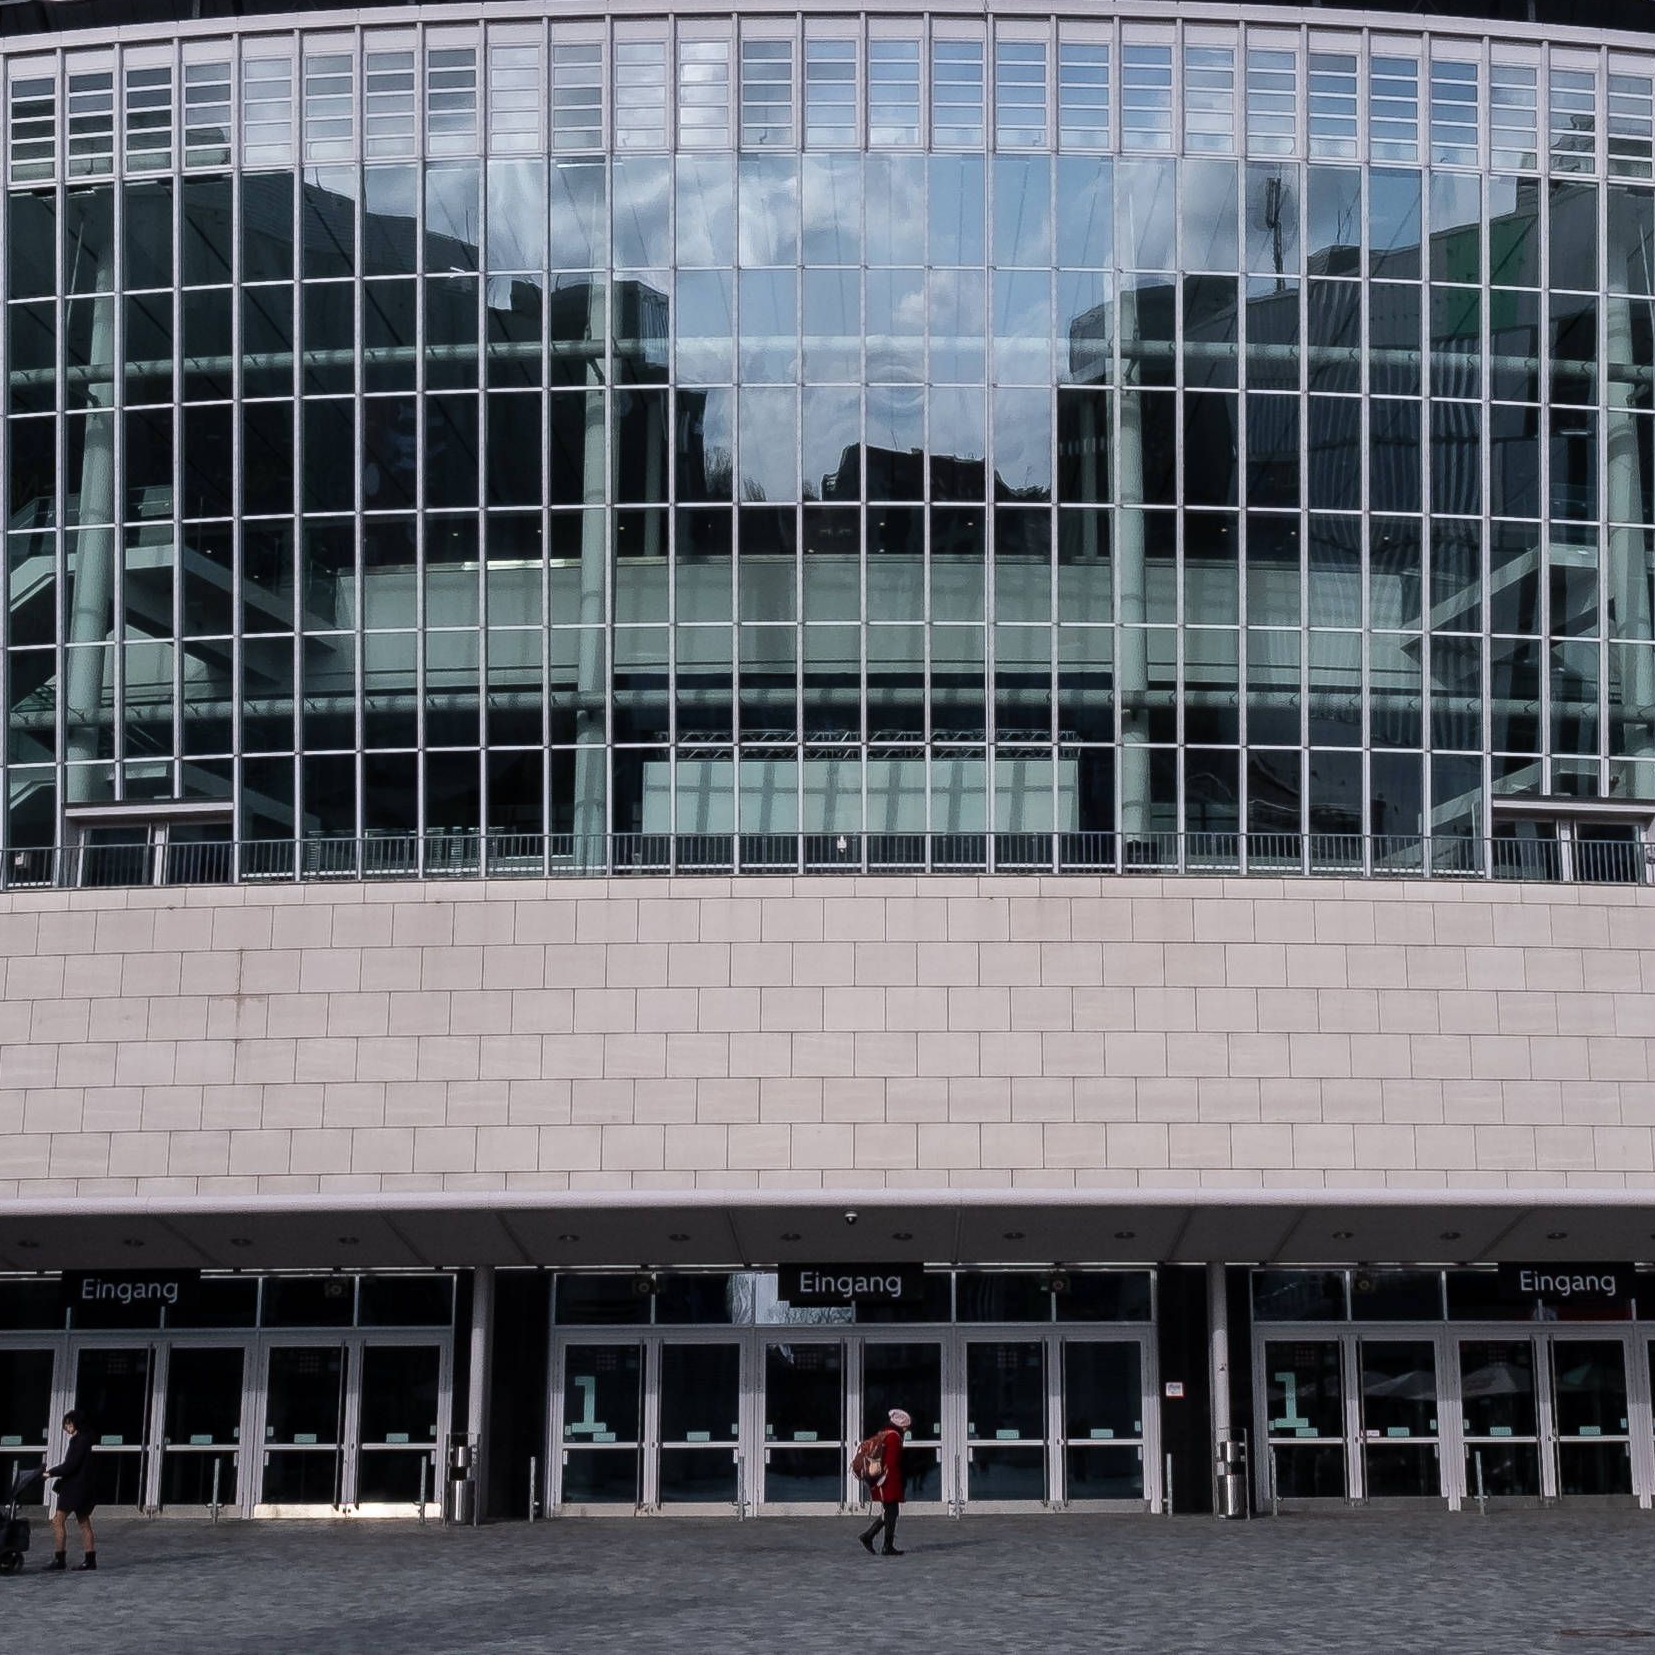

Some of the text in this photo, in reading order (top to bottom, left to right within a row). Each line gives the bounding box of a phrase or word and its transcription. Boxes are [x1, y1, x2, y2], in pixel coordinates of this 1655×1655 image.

[82, 1278, 178, 1304] Eingang
[799, 1272, 902, 1297] Eingang
[1520, 1270, 1616, 1296] Eingang
